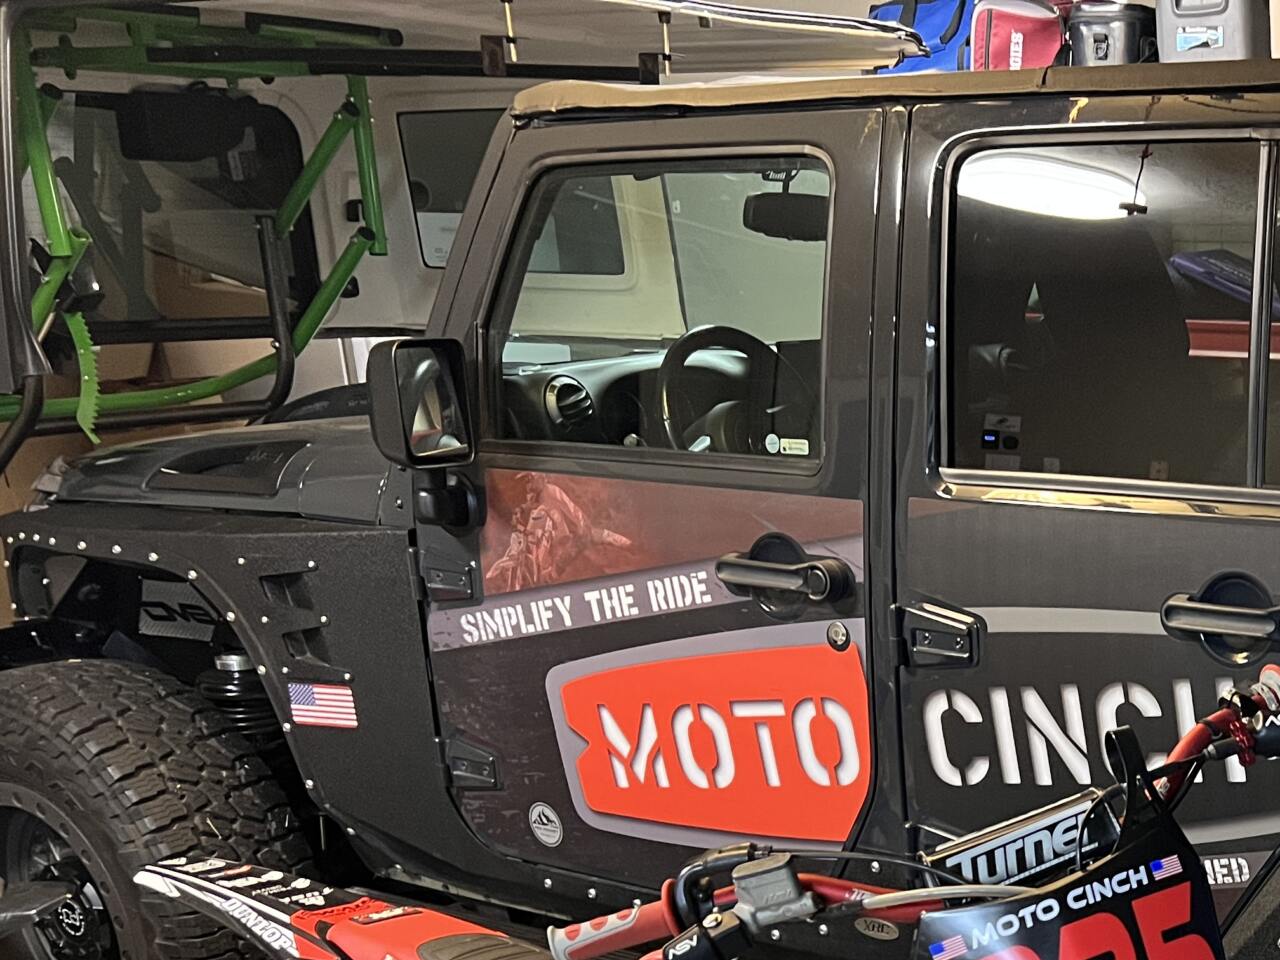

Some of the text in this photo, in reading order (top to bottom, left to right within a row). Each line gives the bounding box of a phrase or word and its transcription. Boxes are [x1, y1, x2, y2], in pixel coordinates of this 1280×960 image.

[459, 571, 713, 644] SIMPLIFY THE RIDE
[597, 697, 861, 789] MOTO
[220, 898, 294, 951] DUNLOP
[971, 865, 1149, 950] MOTO CINCH
[668, 934, 698, 960] ASV
